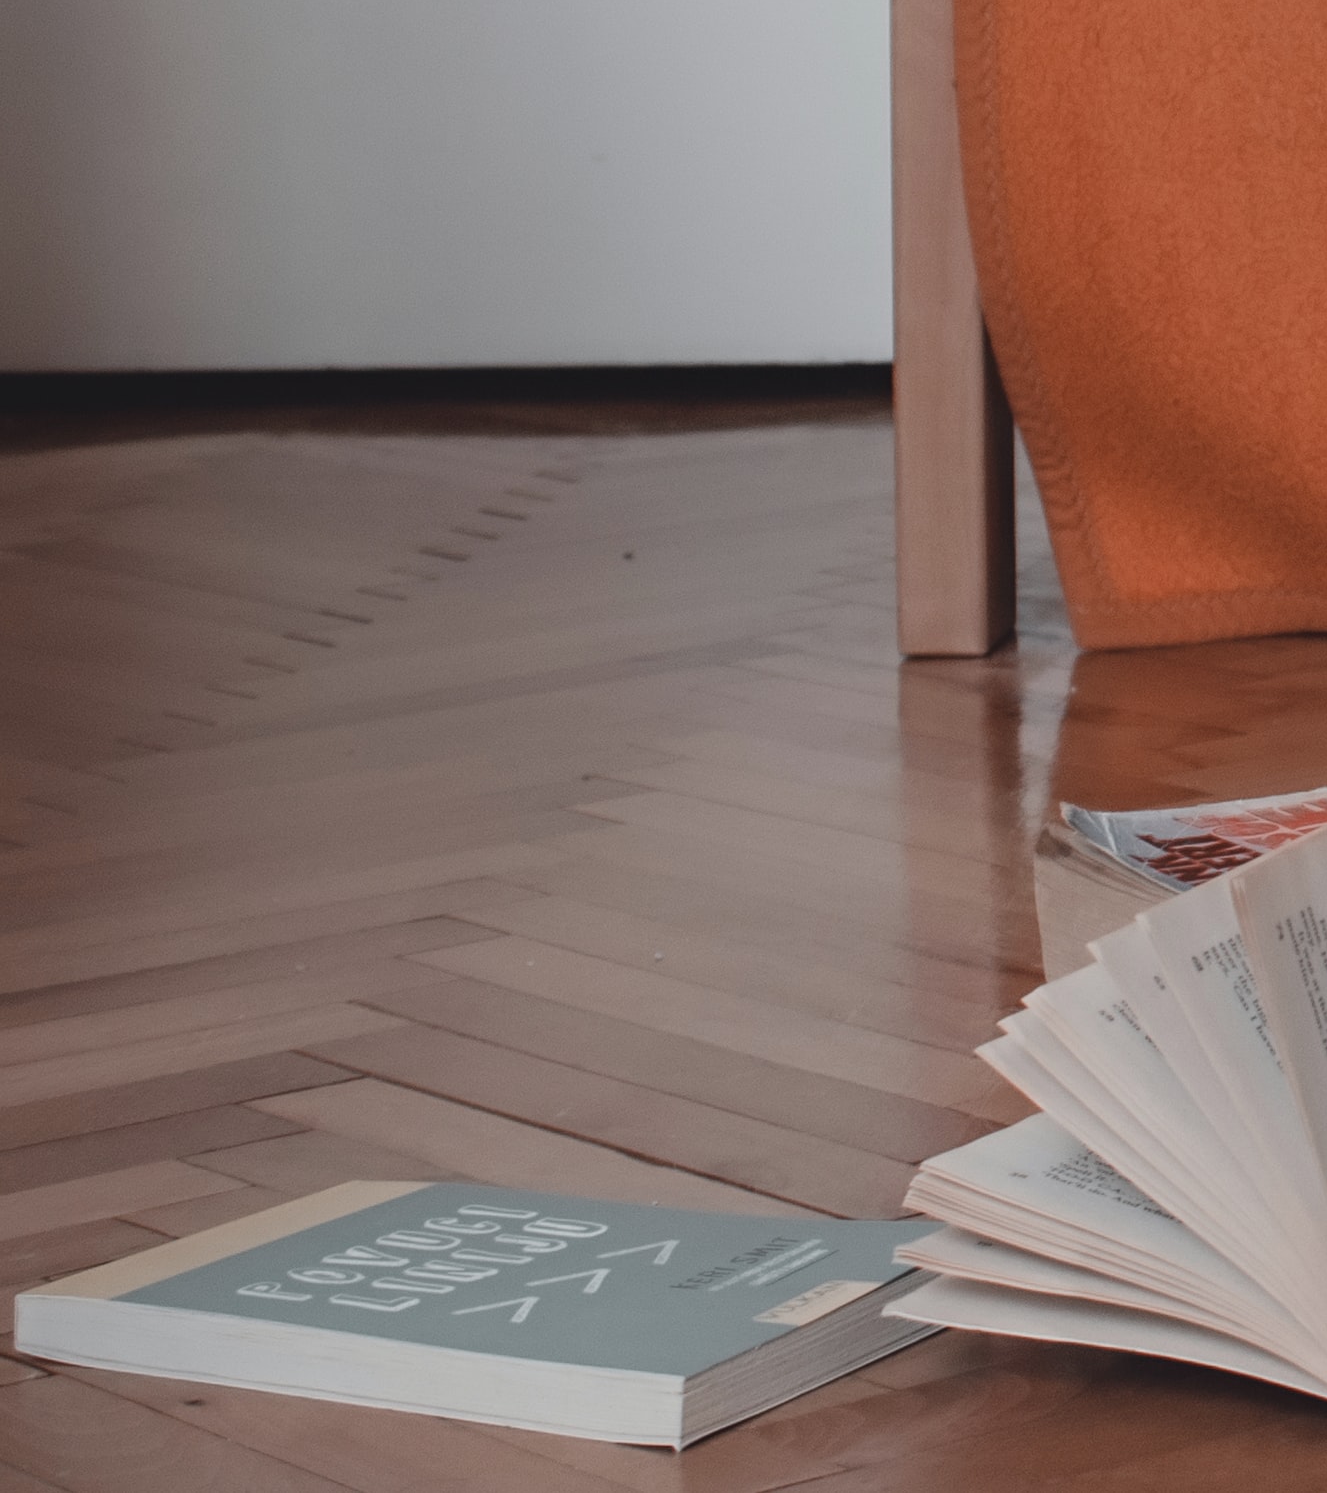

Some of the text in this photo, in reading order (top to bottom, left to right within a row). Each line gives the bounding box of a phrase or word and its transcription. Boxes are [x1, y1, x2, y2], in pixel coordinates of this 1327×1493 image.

[236, 1203, 539, 1301] POVUCI
[329, 1216, 609, 1312] LINIJU
[670, 1235, 801, 1292] KERI SMIT
